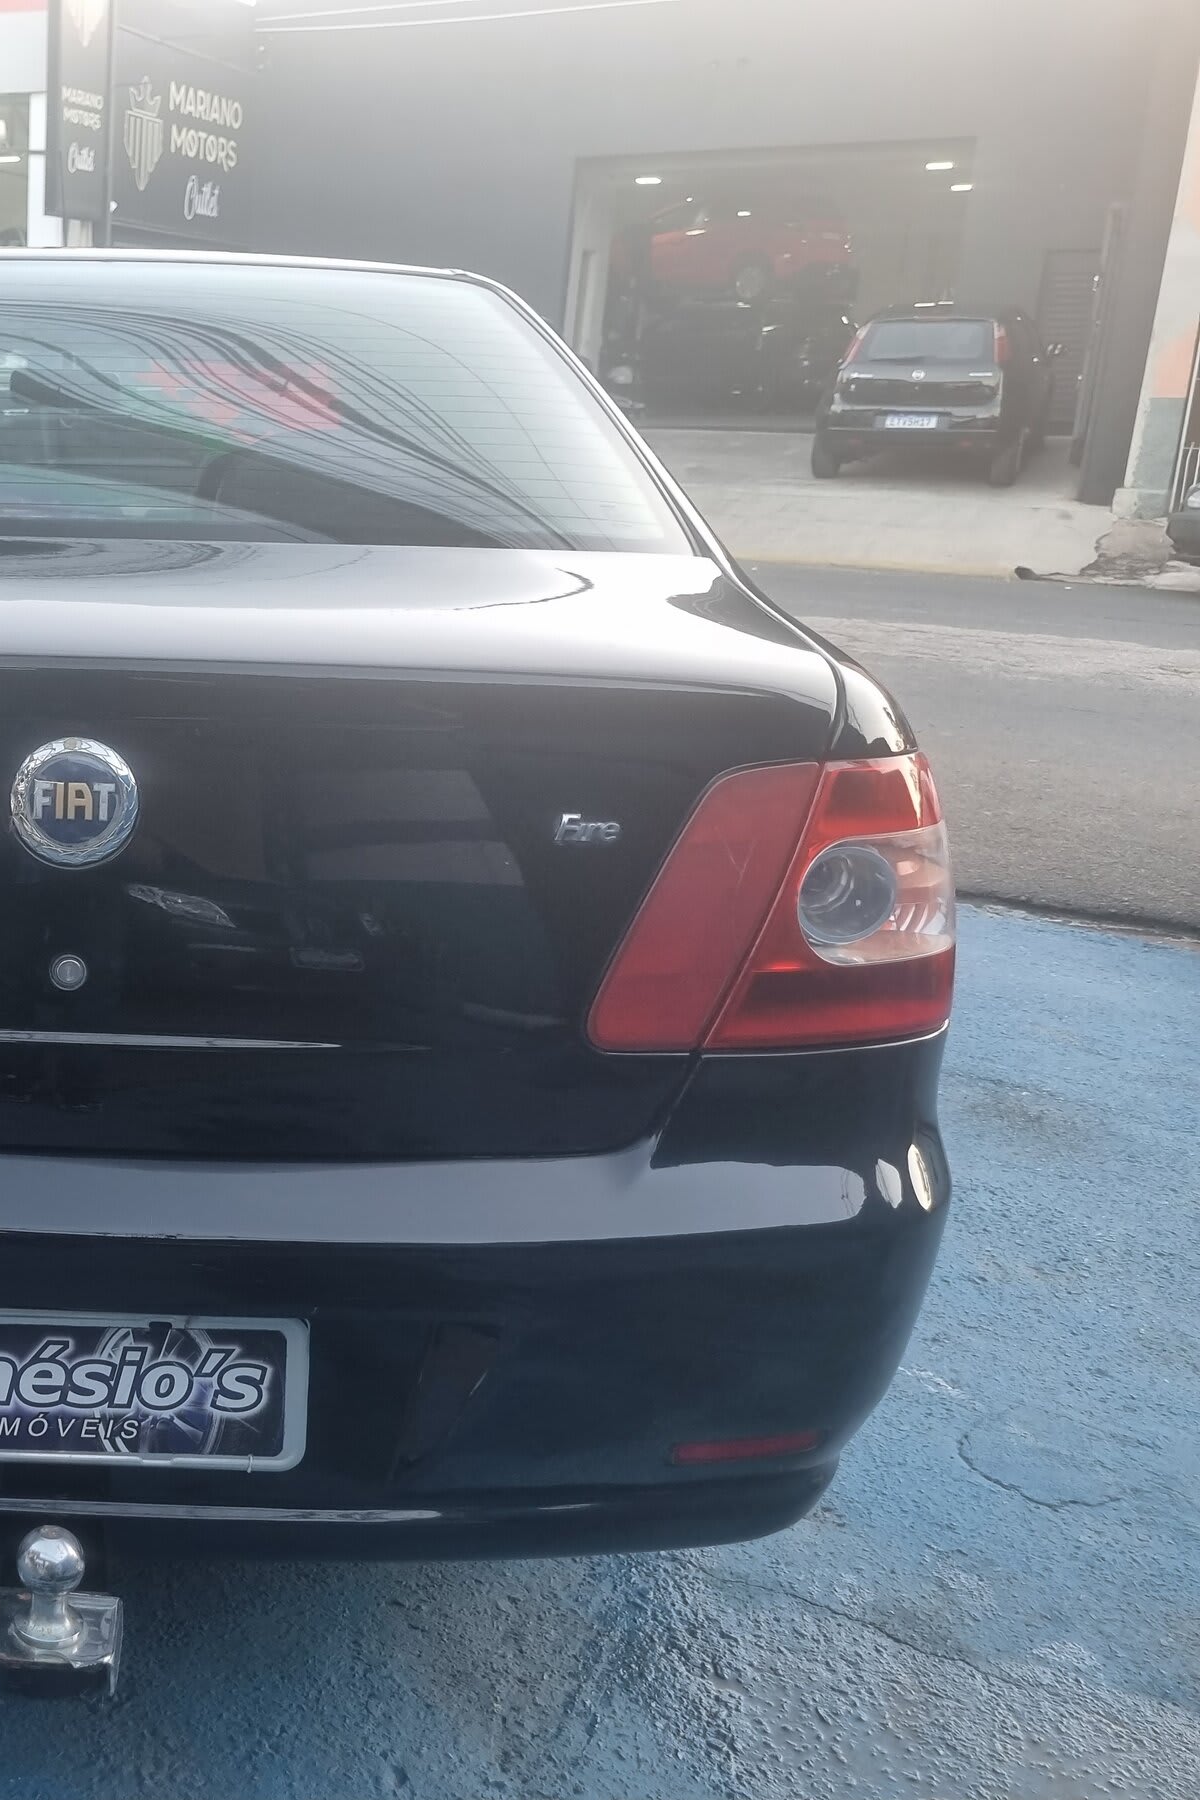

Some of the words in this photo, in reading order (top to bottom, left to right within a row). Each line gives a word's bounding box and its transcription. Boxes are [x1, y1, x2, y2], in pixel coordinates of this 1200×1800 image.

[62, 85, 104, 110] MARIANO
[169, 81, 243, 129] MARIANO
[63, 107, 102, 131] MOTORS
[170, 124, 238, 172] MOTORS
[33, 779, 116, 821] FIAT
[554, 813, 620, 841] Fire
